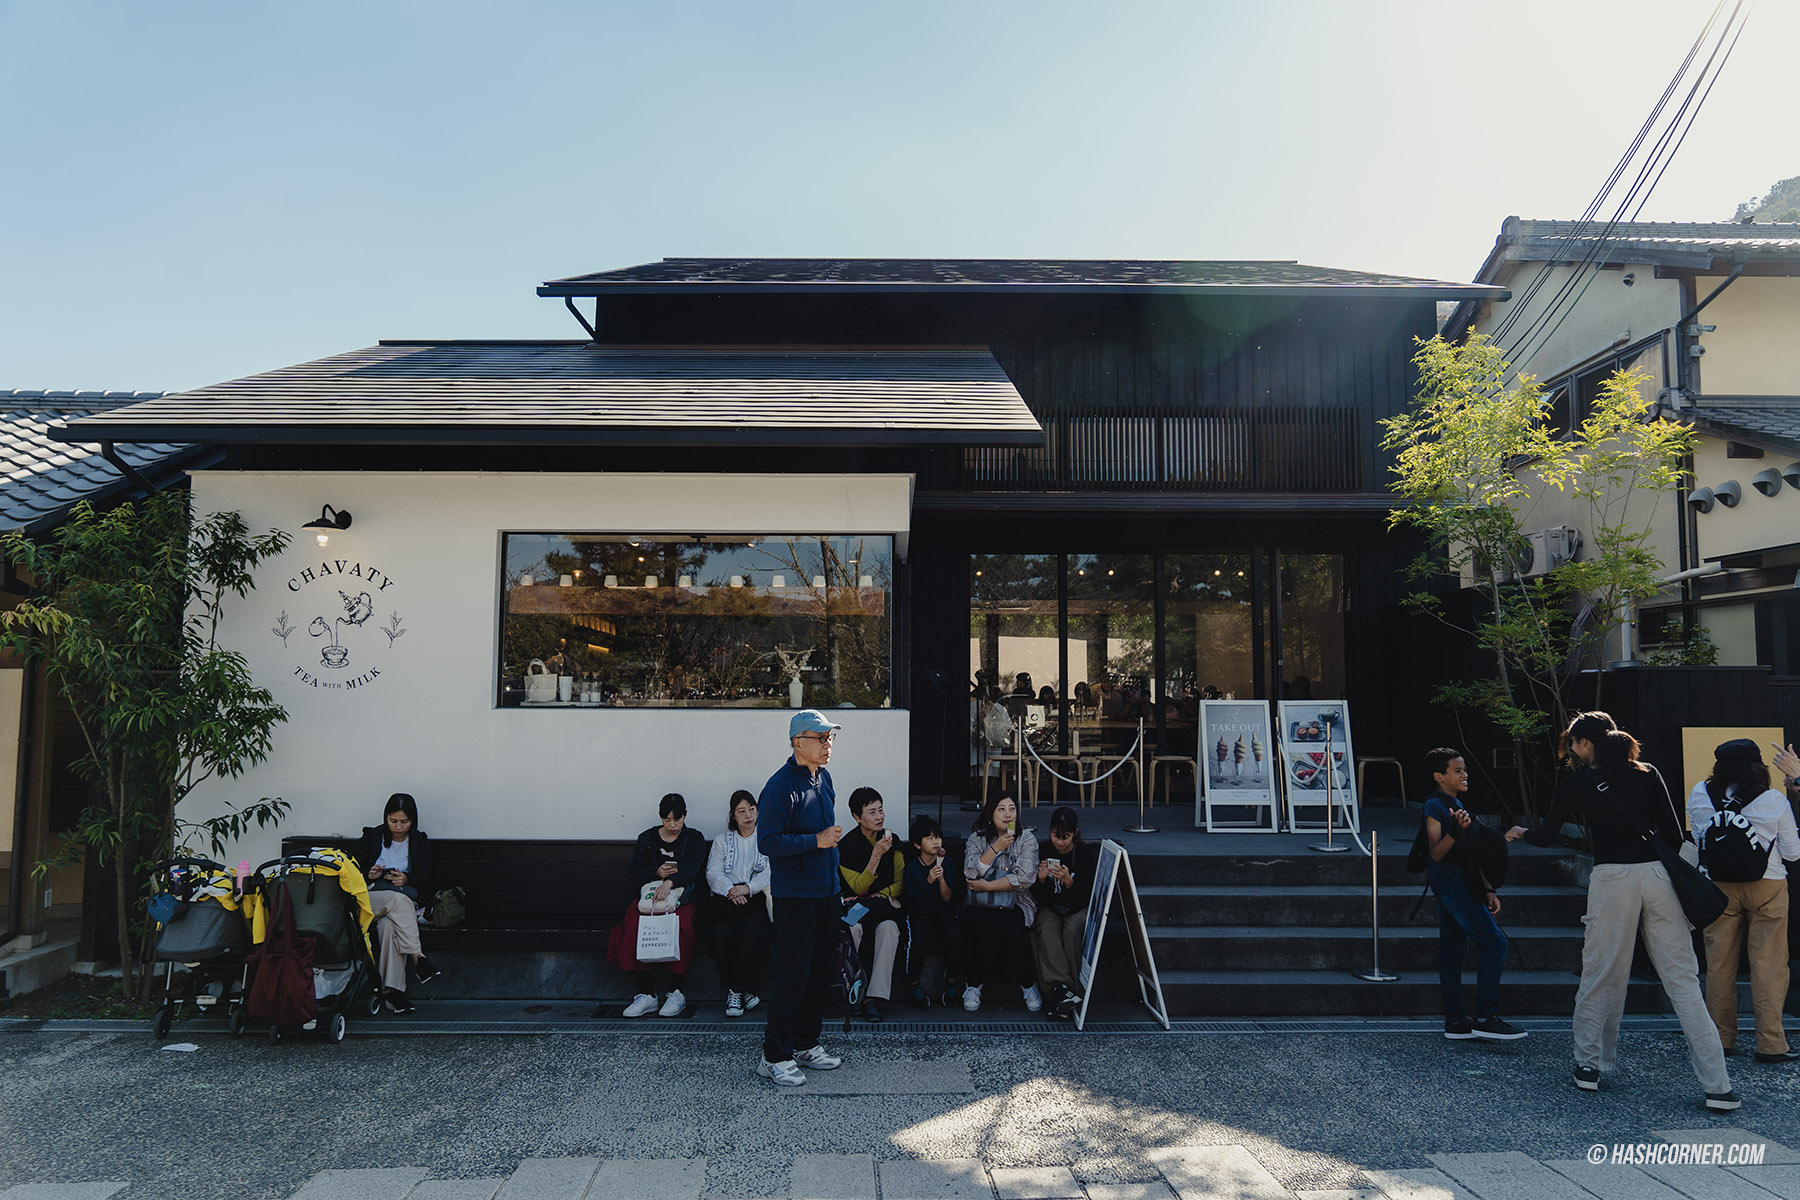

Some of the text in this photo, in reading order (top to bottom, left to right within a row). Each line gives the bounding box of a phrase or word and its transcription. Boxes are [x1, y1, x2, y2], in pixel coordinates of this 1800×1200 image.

[287, 560, 394, 592] CHAVATY
[293, 666, 318, 688] TEA
[346, 666, 381, 690] MILK
[1210, 723, 1262, 732] TAKE OUT
